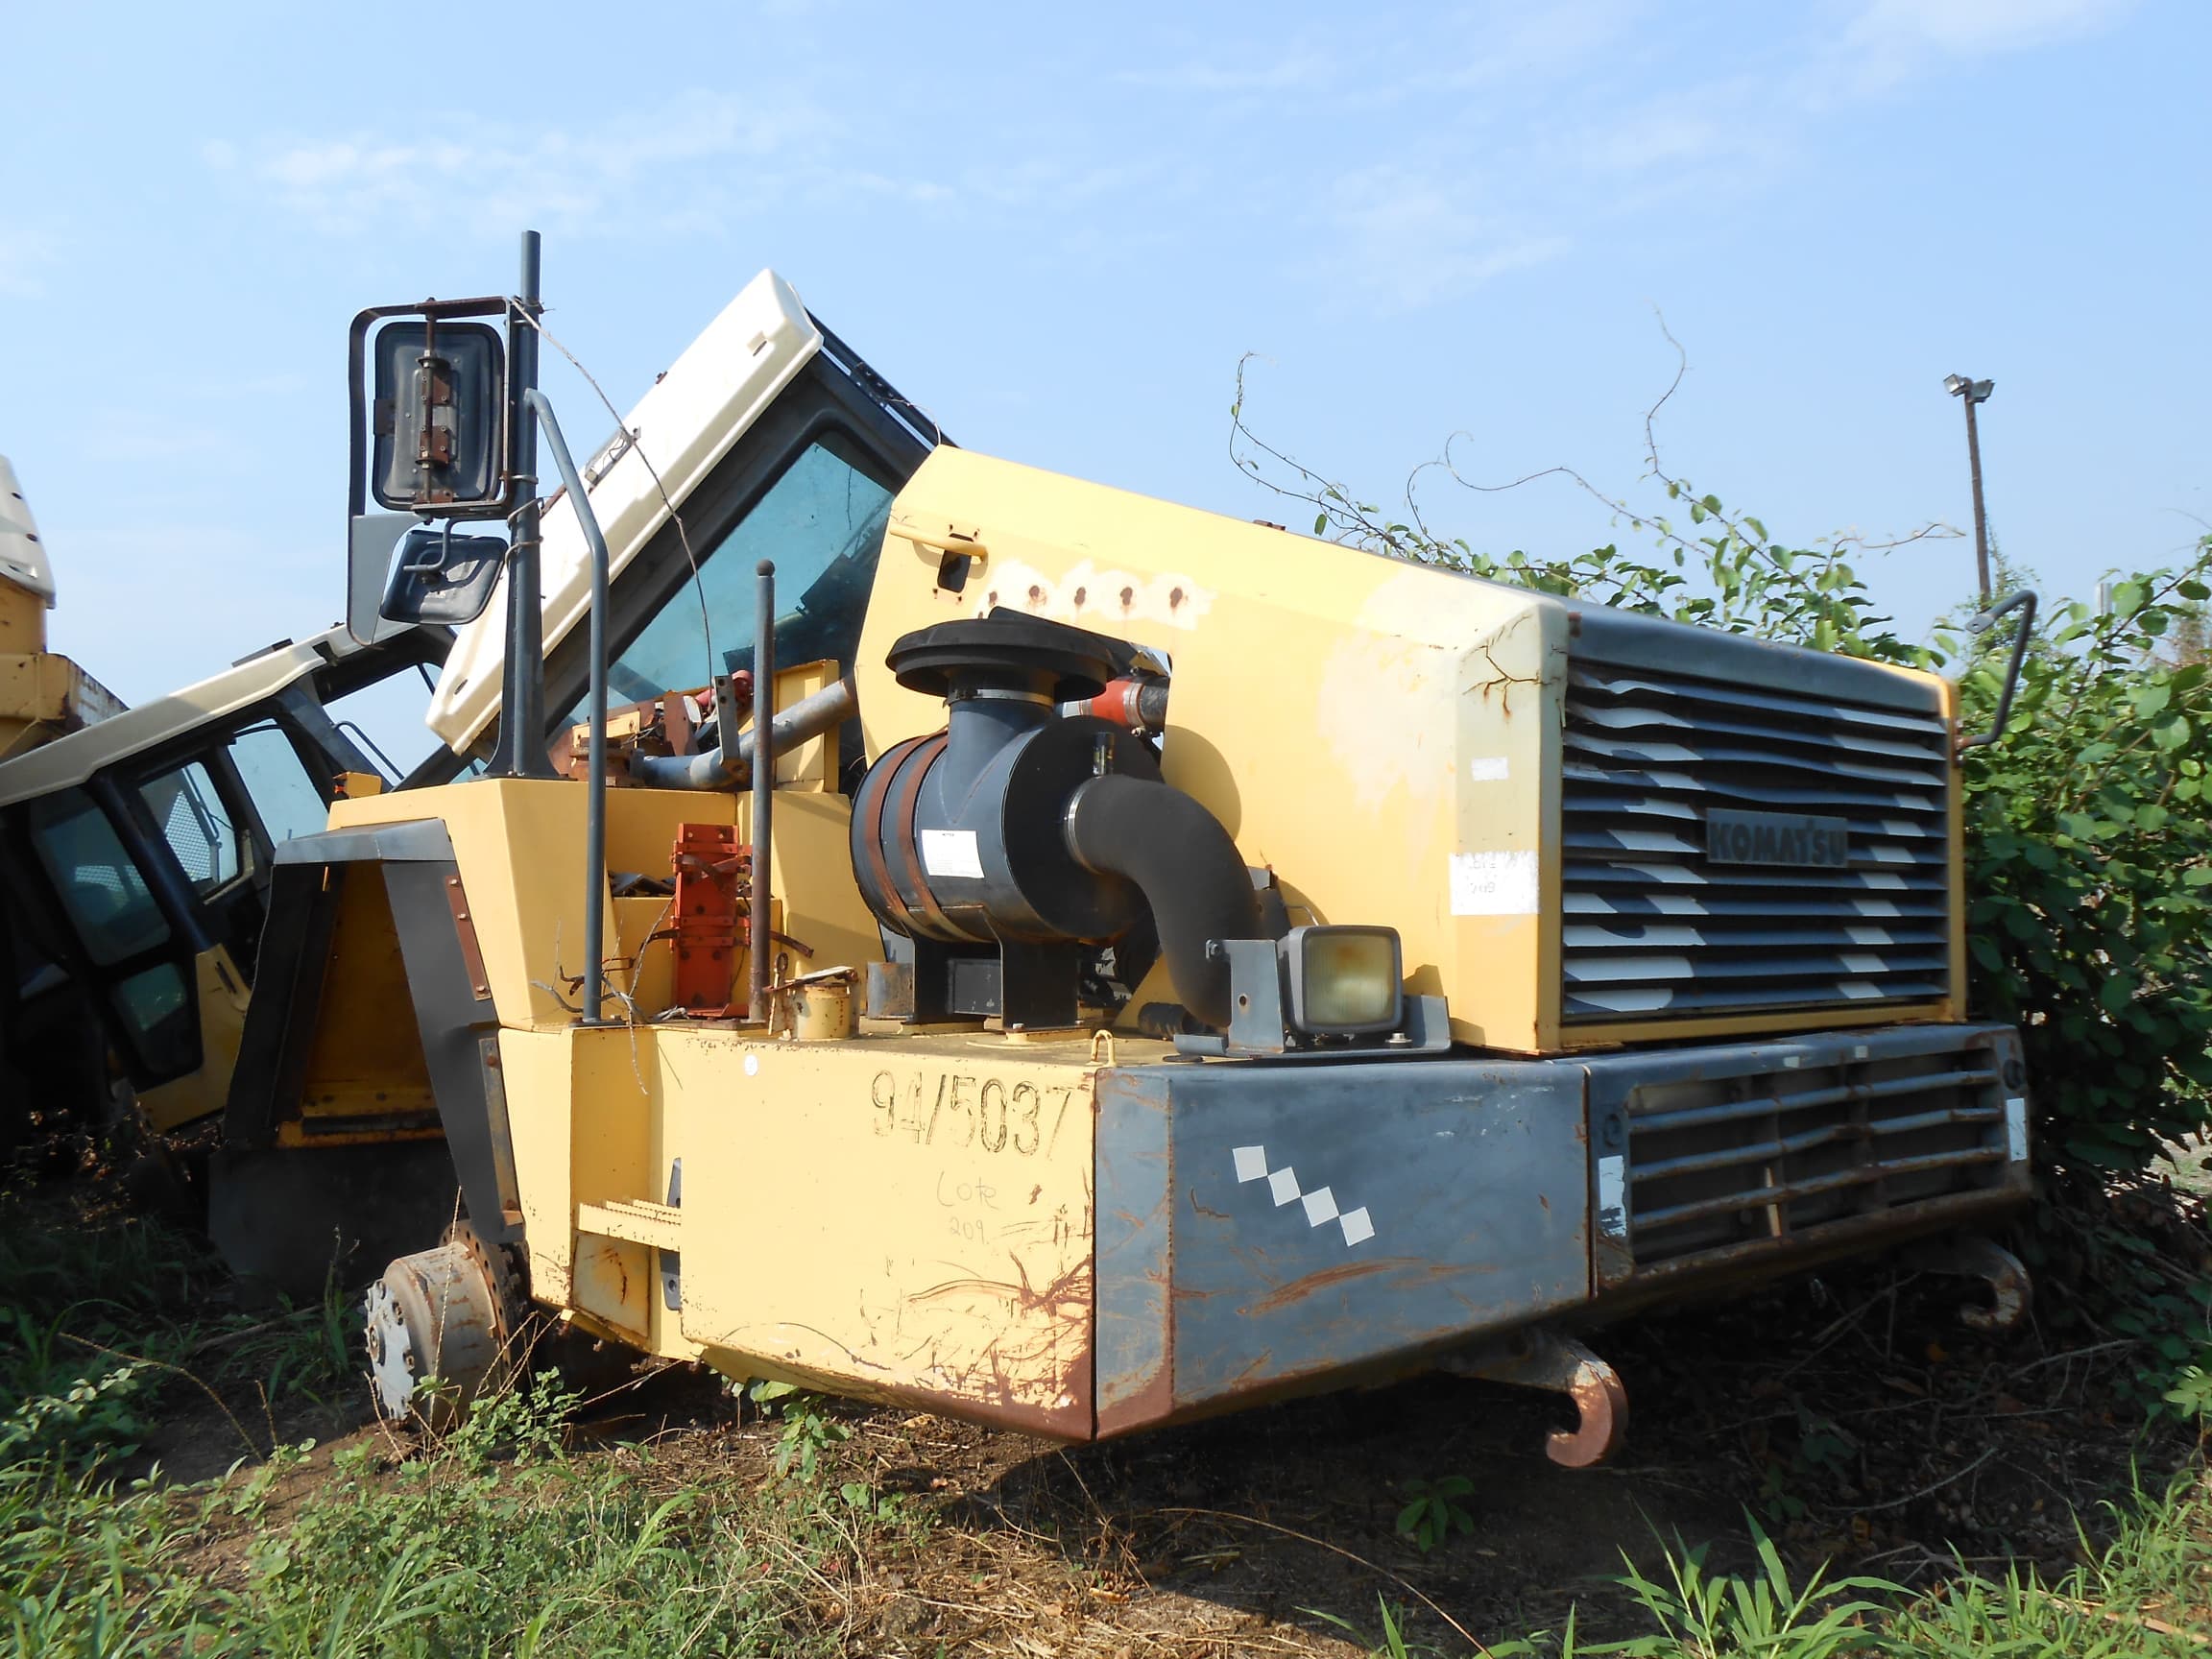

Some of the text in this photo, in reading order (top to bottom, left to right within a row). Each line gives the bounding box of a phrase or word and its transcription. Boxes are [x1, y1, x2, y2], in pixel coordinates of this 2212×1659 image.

[1709, 818, 1845, 865] KOMATSU
[871, 1069, 1075, 1162] 94/5037
[950, 1216, 986, 1245] 209
